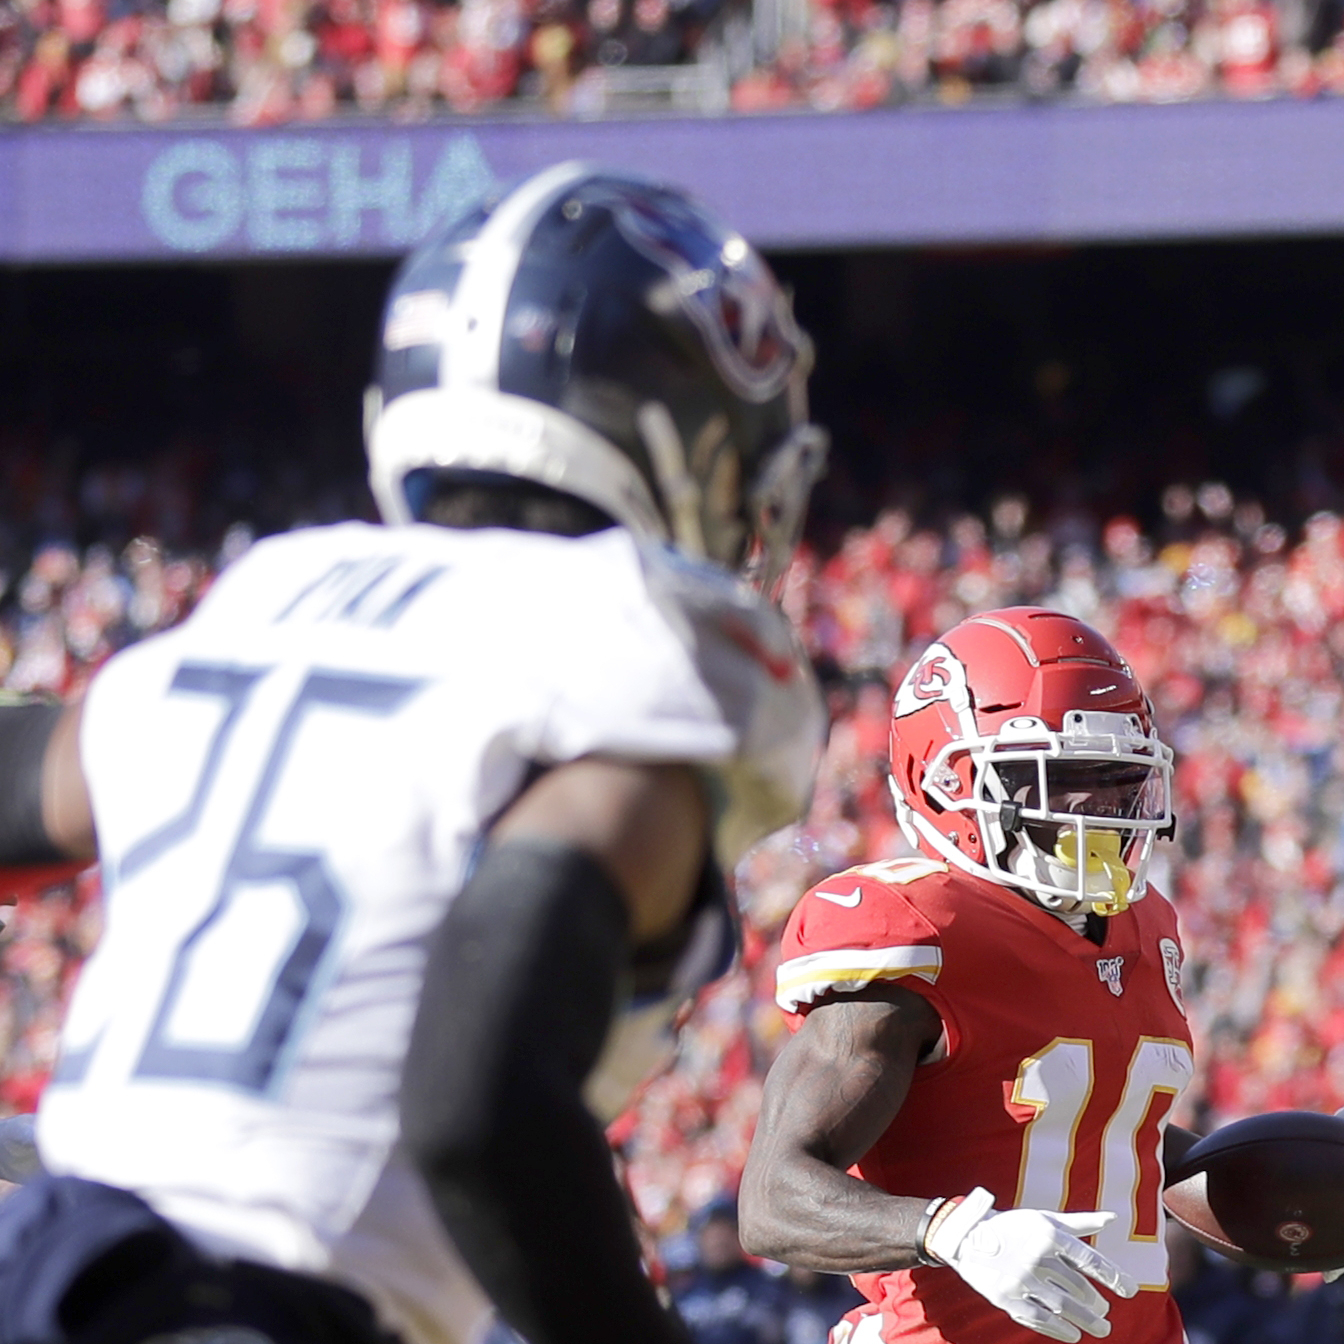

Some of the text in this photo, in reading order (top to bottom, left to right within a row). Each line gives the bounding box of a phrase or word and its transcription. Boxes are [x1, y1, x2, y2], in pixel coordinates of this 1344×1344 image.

[142, 132, 498, 254] GEHA
[52, 657, 431, 1104] 26
[1010, 1035, 1194, 1292] 10
